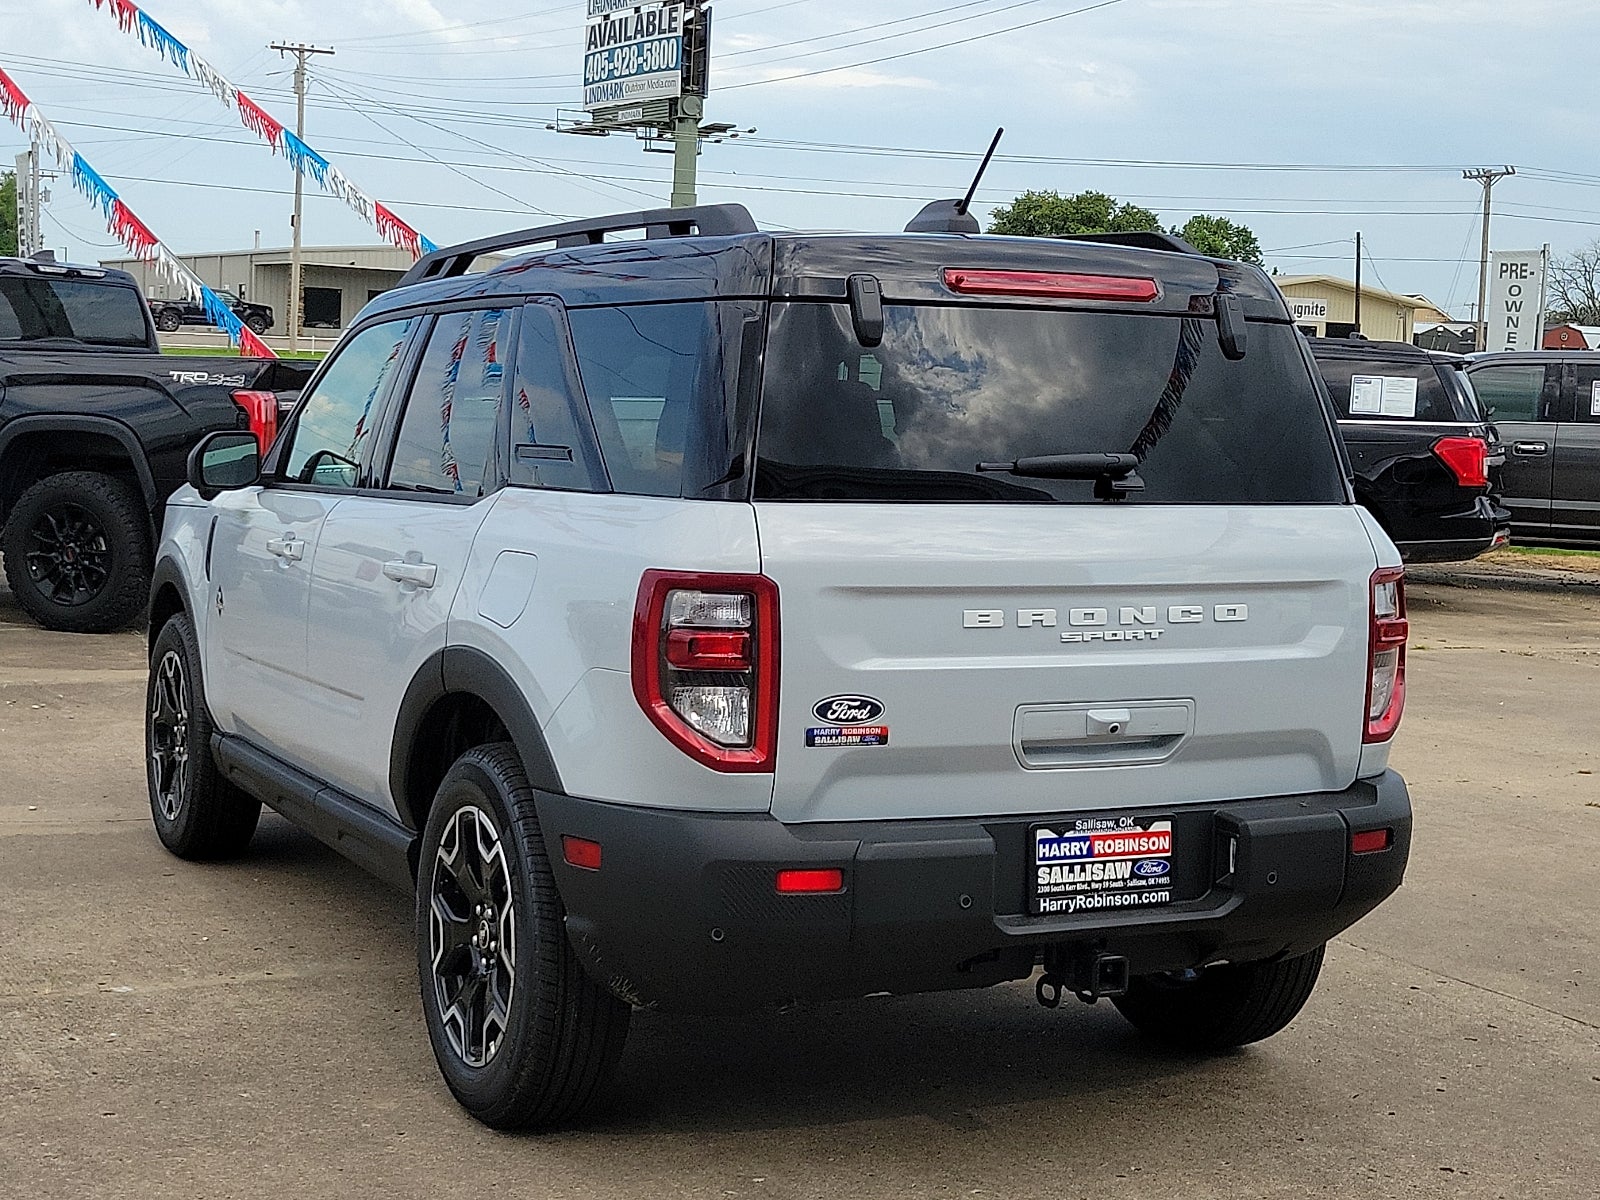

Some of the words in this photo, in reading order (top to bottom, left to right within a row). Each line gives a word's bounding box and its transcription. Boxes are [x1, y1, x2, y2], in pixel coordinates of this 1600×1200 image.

[587, 6, 679, 51] AVAILABLE
[585, 38, 678, 82] 405-928-5800
[584, 81, 625, 105] LINDMARK
[624, 83, 646, 93] Outdoor
[647, 78, 677, 90] Media.com
[1499, 262, 1535, 279] PRE-
[169, 370, 209, 384] TRD
[962, 603, 1249, 629] BRONCO
[1060, 629, 1166, 644] SPORT
[814, 728, 841, 736] HARRY
[842, 727, 882, 736] ROBINSON
[814, 735, 861, 744] SALLISAW
[1075, 818, 1117, 831] Sallisaw,
[1118, 815, 1135, 828] OK
[1038, 841, 1090, 858] HARRY
[1094, 836, 1170, 855] ROBINSON
[1037, 861, 1133, 884] SALLISAW
[1039, 890, 1170, 913] HarryRobinson.com
